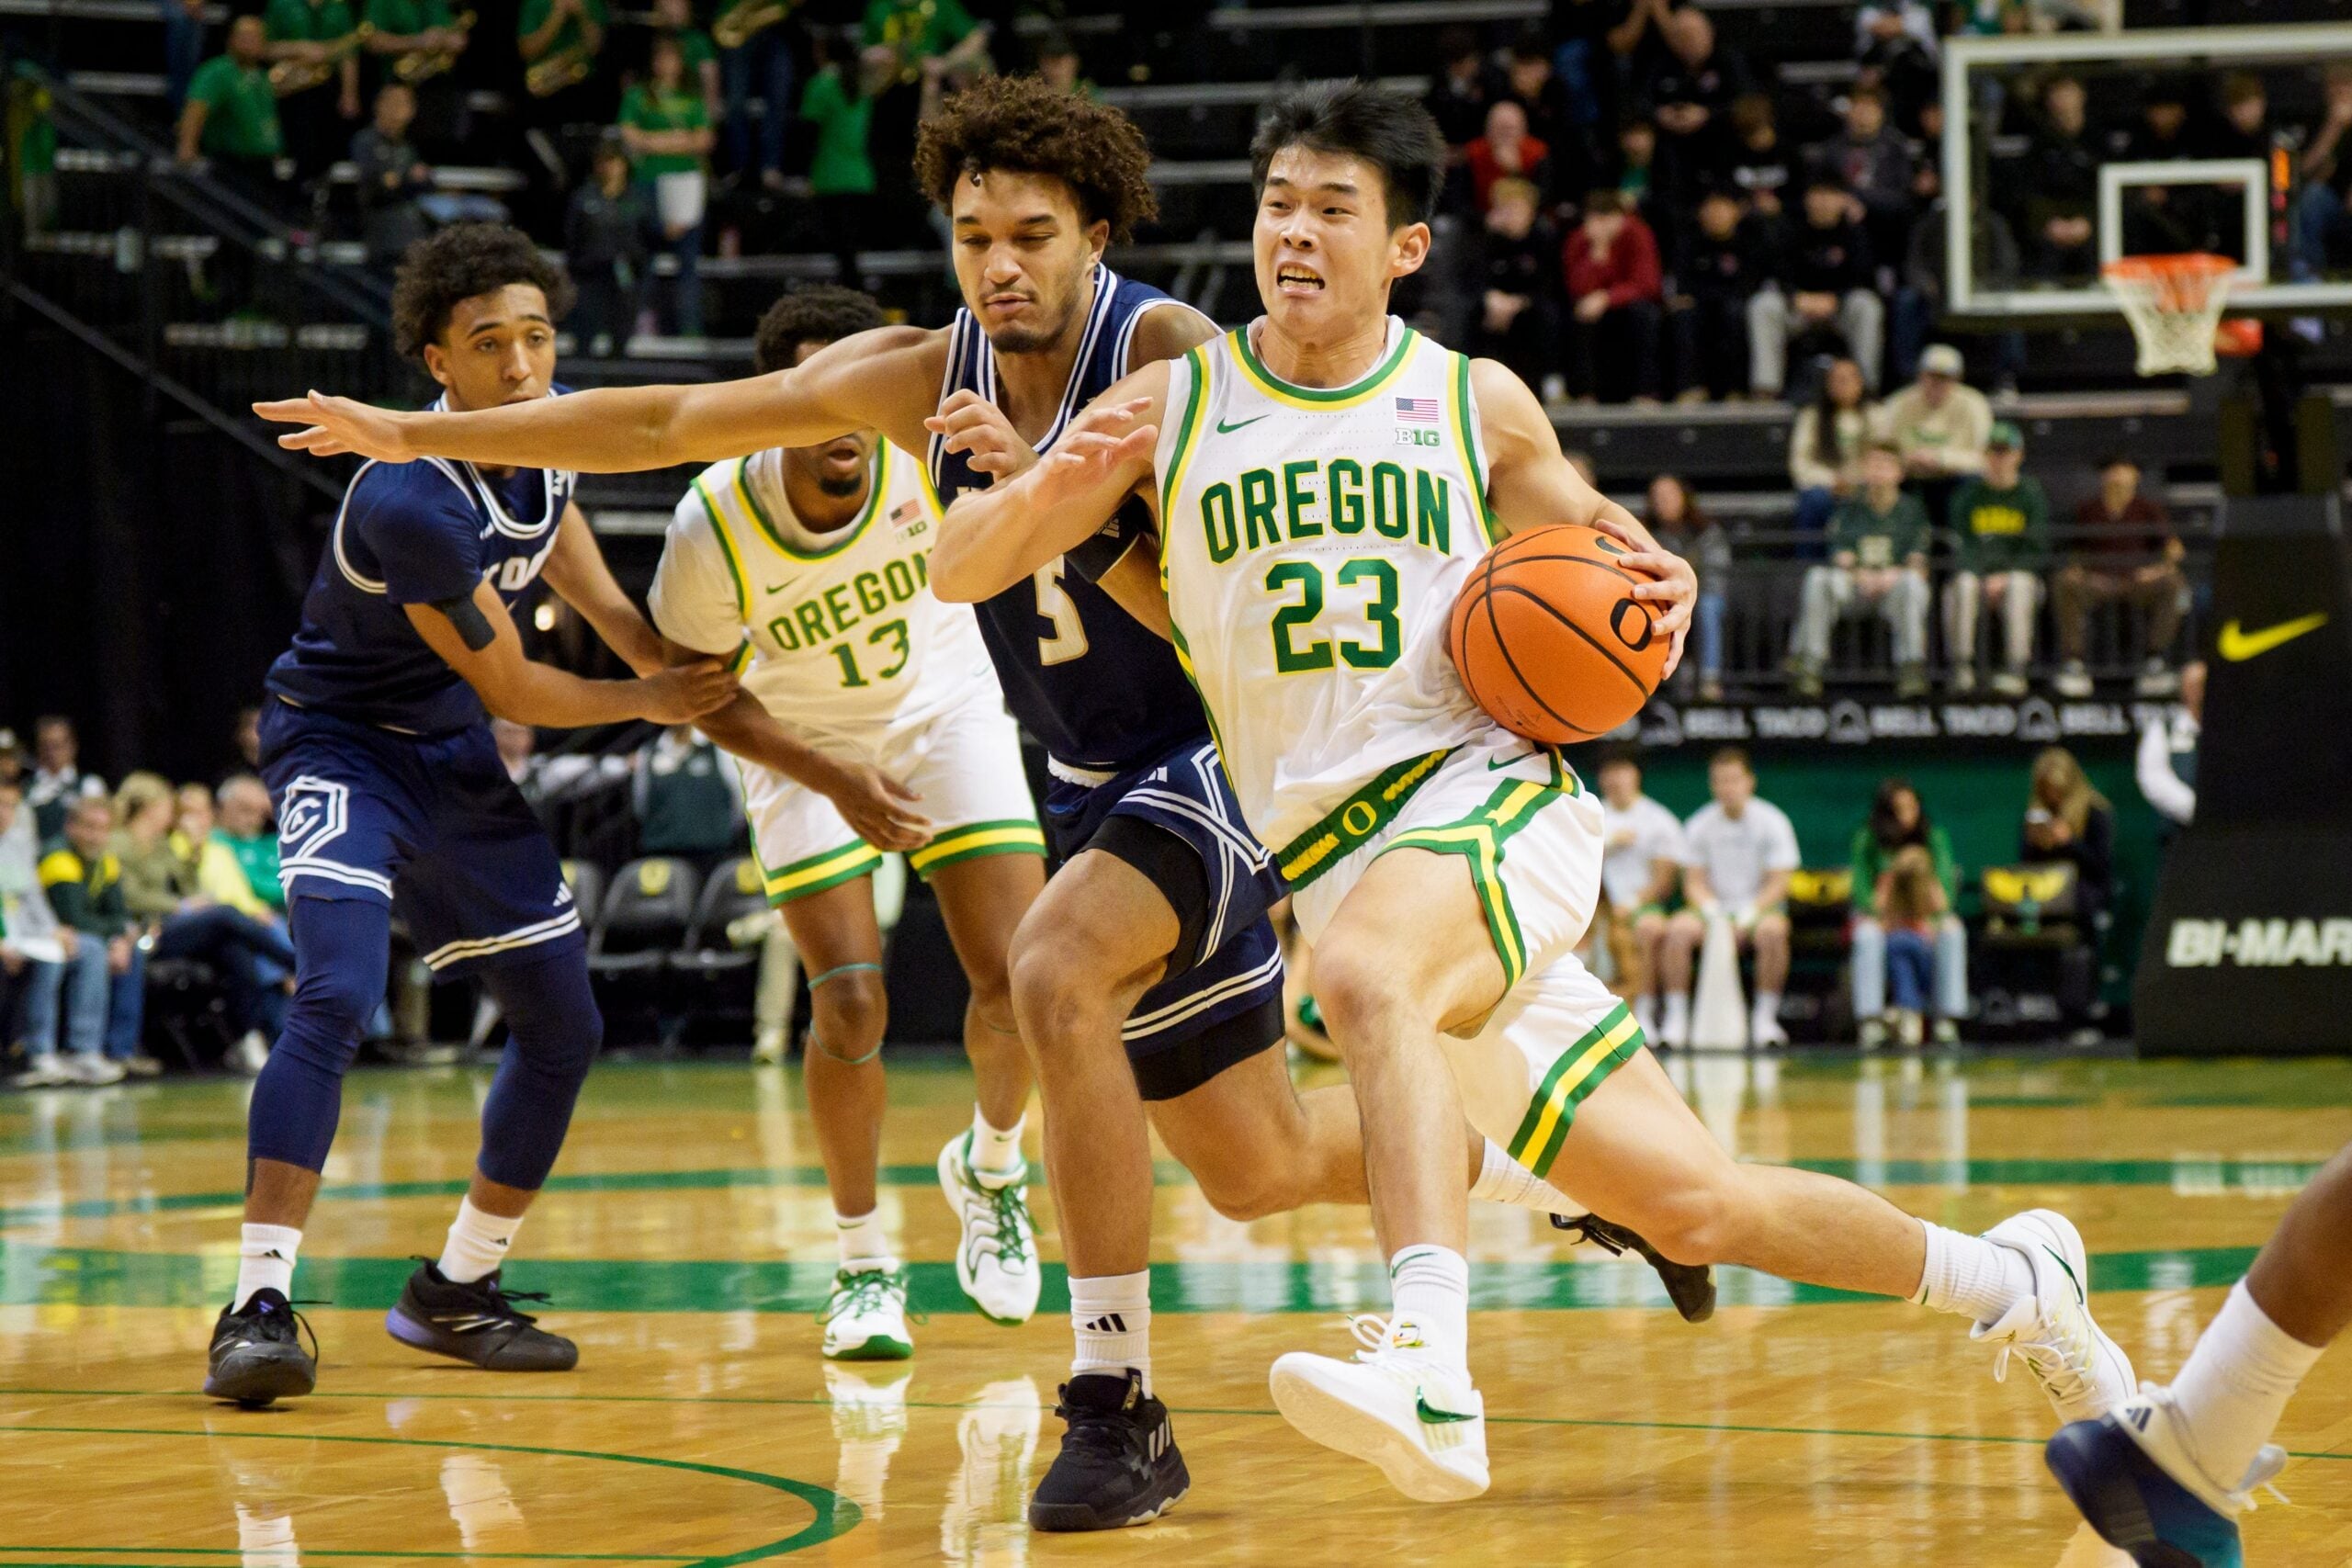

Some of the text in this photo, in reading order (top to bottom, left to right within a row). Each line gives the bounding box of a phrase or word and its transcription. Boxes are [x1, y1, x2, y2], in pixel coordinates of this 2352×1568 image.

[1200, 458, 1452, 566] OREGON
[830, 618, 910, 688] 13
[1035, 554, 1090, 666] 5
[1265, 558, 1403, 674] 23
[1342, 800, 1376, 836] O
